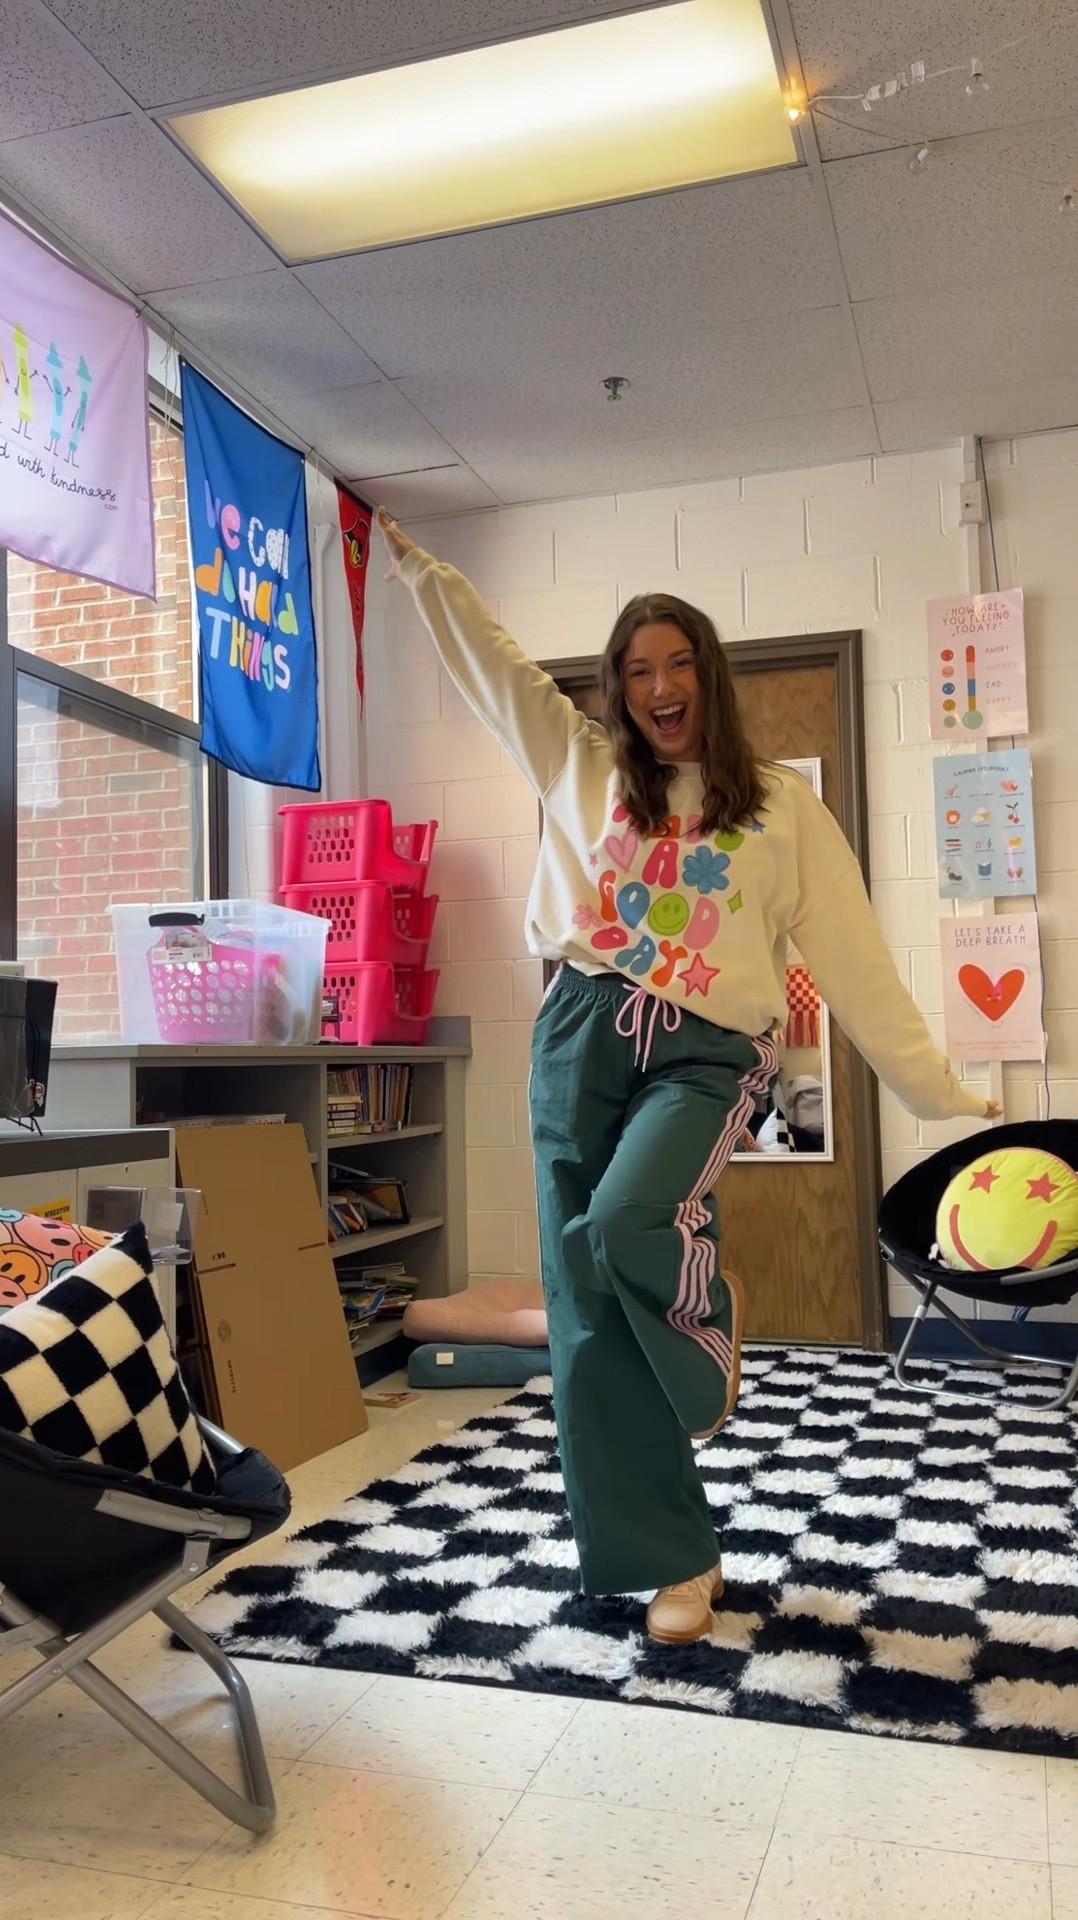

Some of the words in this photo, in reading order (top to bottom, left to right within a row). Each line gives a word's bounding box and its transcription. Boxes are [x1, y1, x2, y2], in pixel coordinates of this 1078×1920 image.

[18, 455, 45, 478] with
[50, 467, 116, 502] kindness
[951, 604, 975, 616] HOW
[980, 602, 999, 613] ARE
[942, 615, 965, 627] YOU
[955, 622, 997, 635] TODAY?
[985, 680, 1002, 689] SAD
[955, 927, 981, 938] LET'S
[987, 925, 1012, 936] TAKE
[1019, 924, 1025, 934] A
[955, 937, 981, 948] DEEP
[986, 935, 1026, 946] BREATH
[590, 926, 688, 988] DAY
